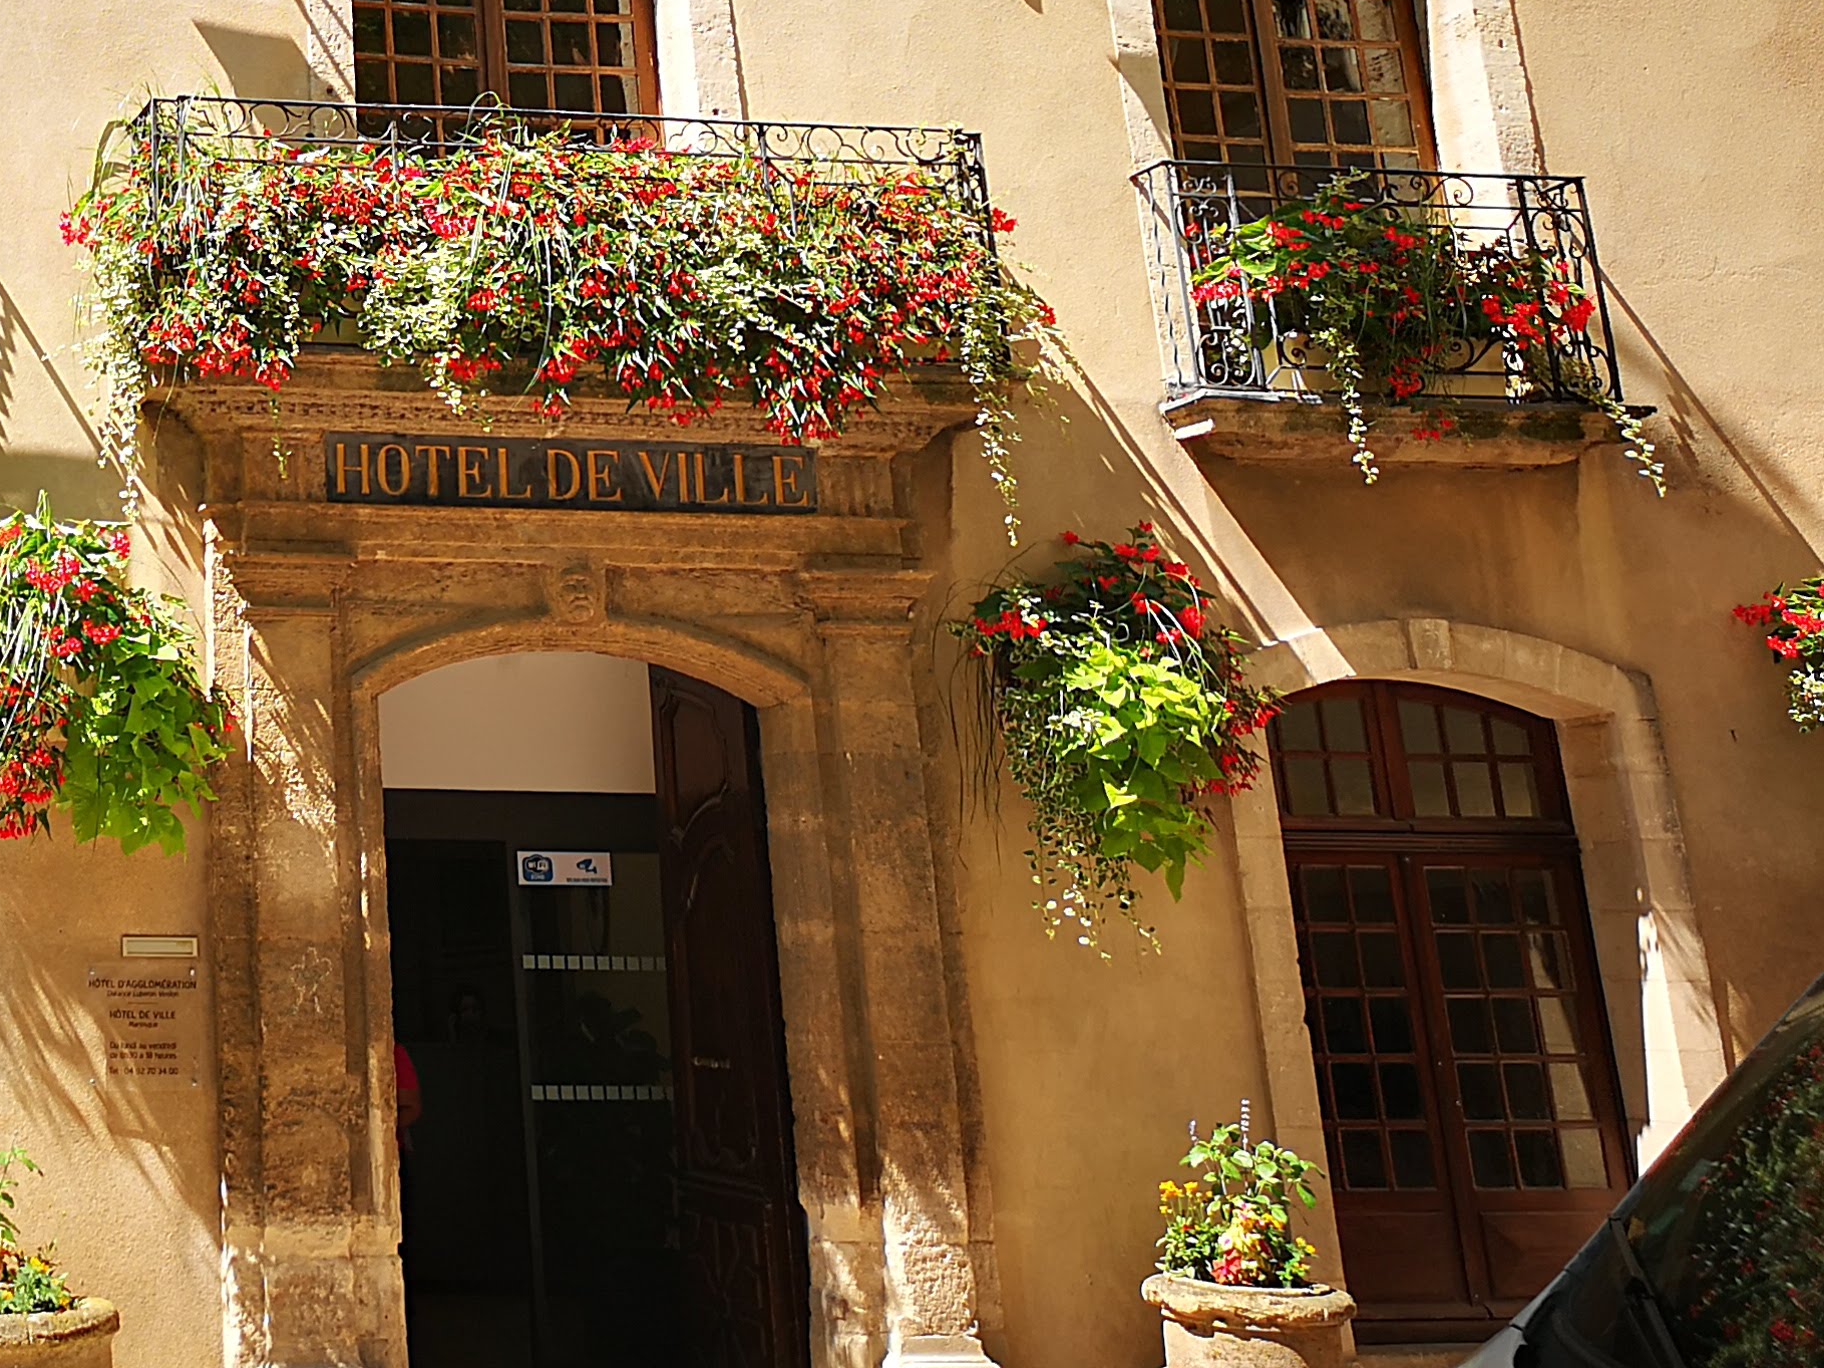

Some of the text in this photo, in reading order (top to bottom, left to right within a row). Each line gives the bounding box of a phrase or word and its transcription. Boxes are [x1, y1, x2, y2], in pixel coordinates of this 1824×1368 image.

[335, 443, 809, 507] HOTEL DE VILLE
[138, 1010, 150, 1019] DE
[153, 1010, 176, 1019] VILLE
